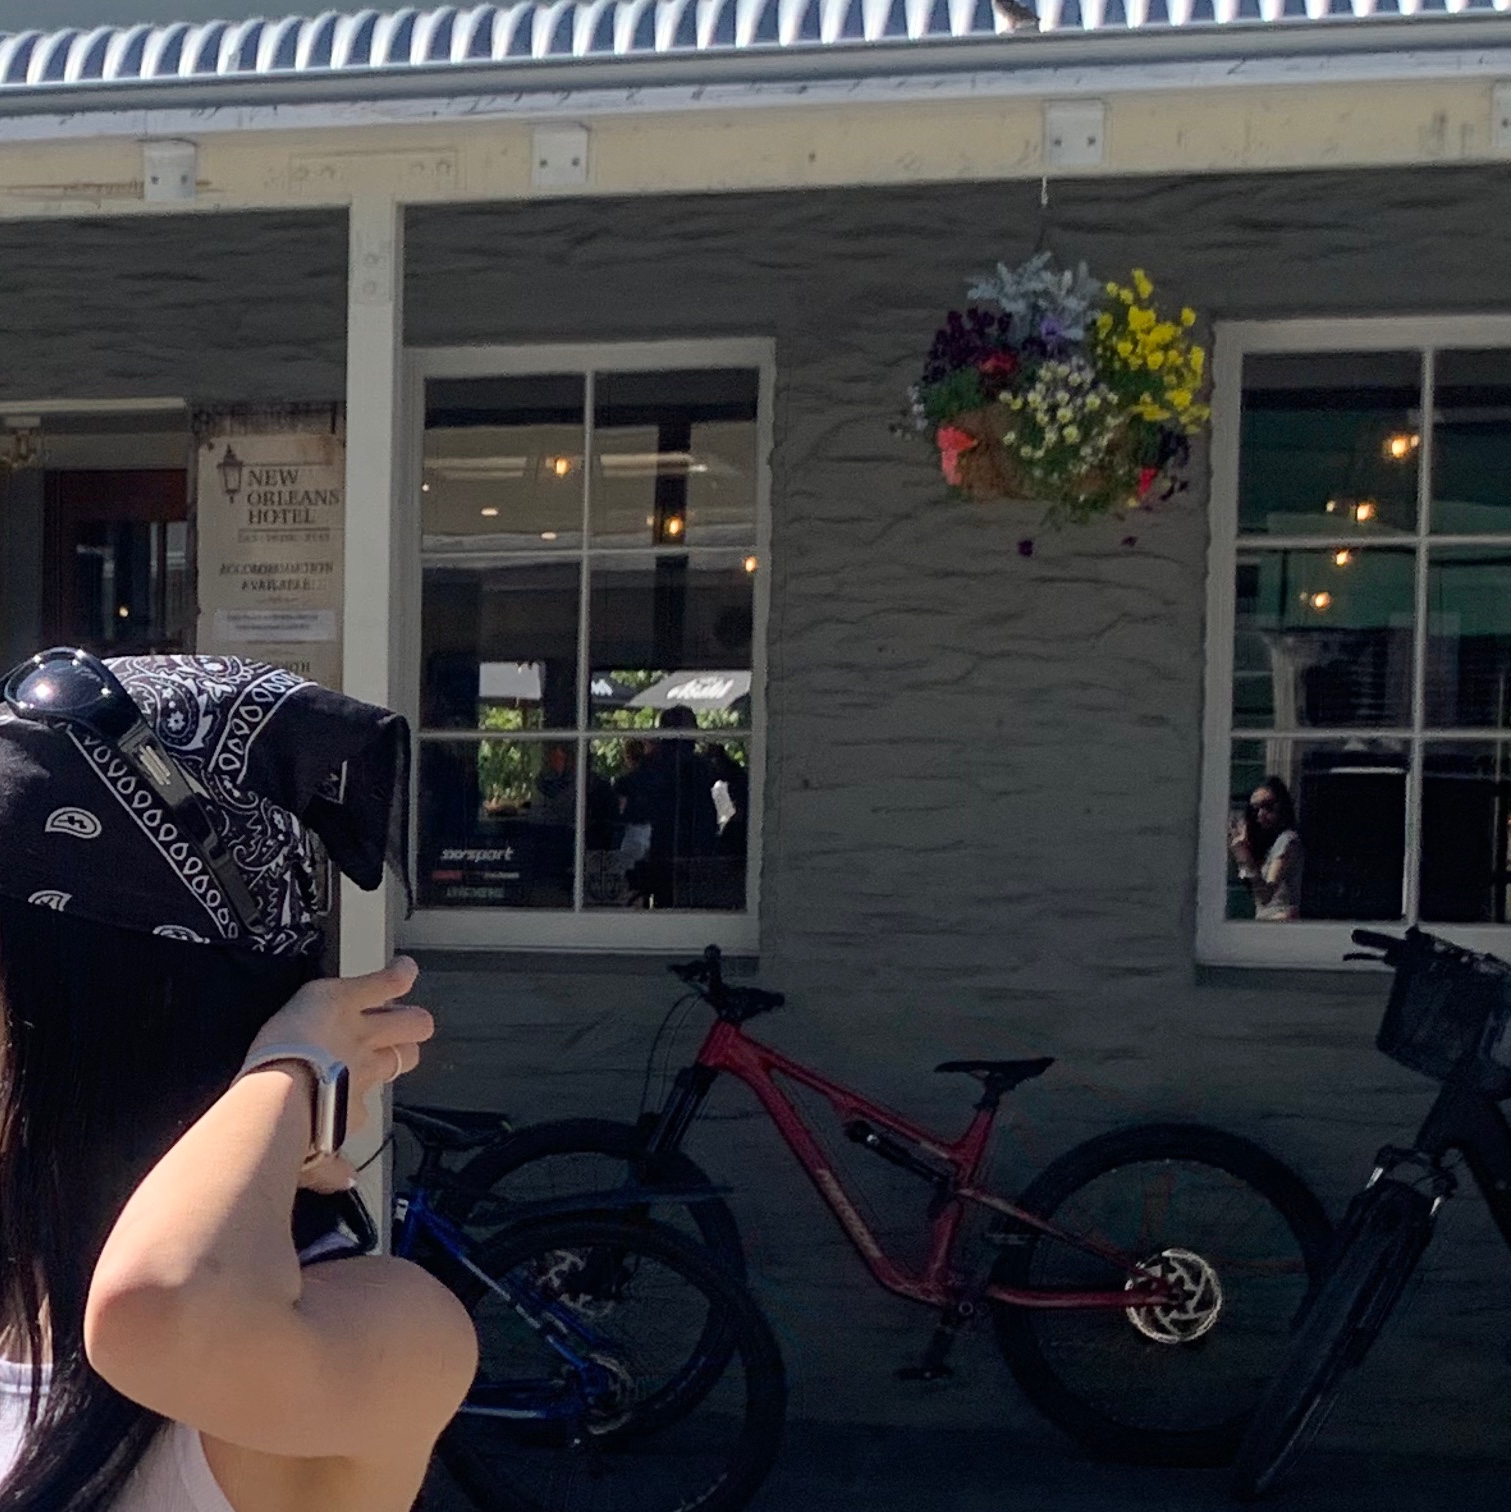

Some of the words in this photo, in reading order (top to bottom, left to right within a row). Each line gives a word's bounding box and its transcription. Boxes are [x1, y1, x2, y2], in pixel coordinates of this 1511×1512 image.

[247, 468, 300, 487] NEW
[247, 489, 340, 507] ORLEANS
[248, 508, 316, 525] HOTEL
